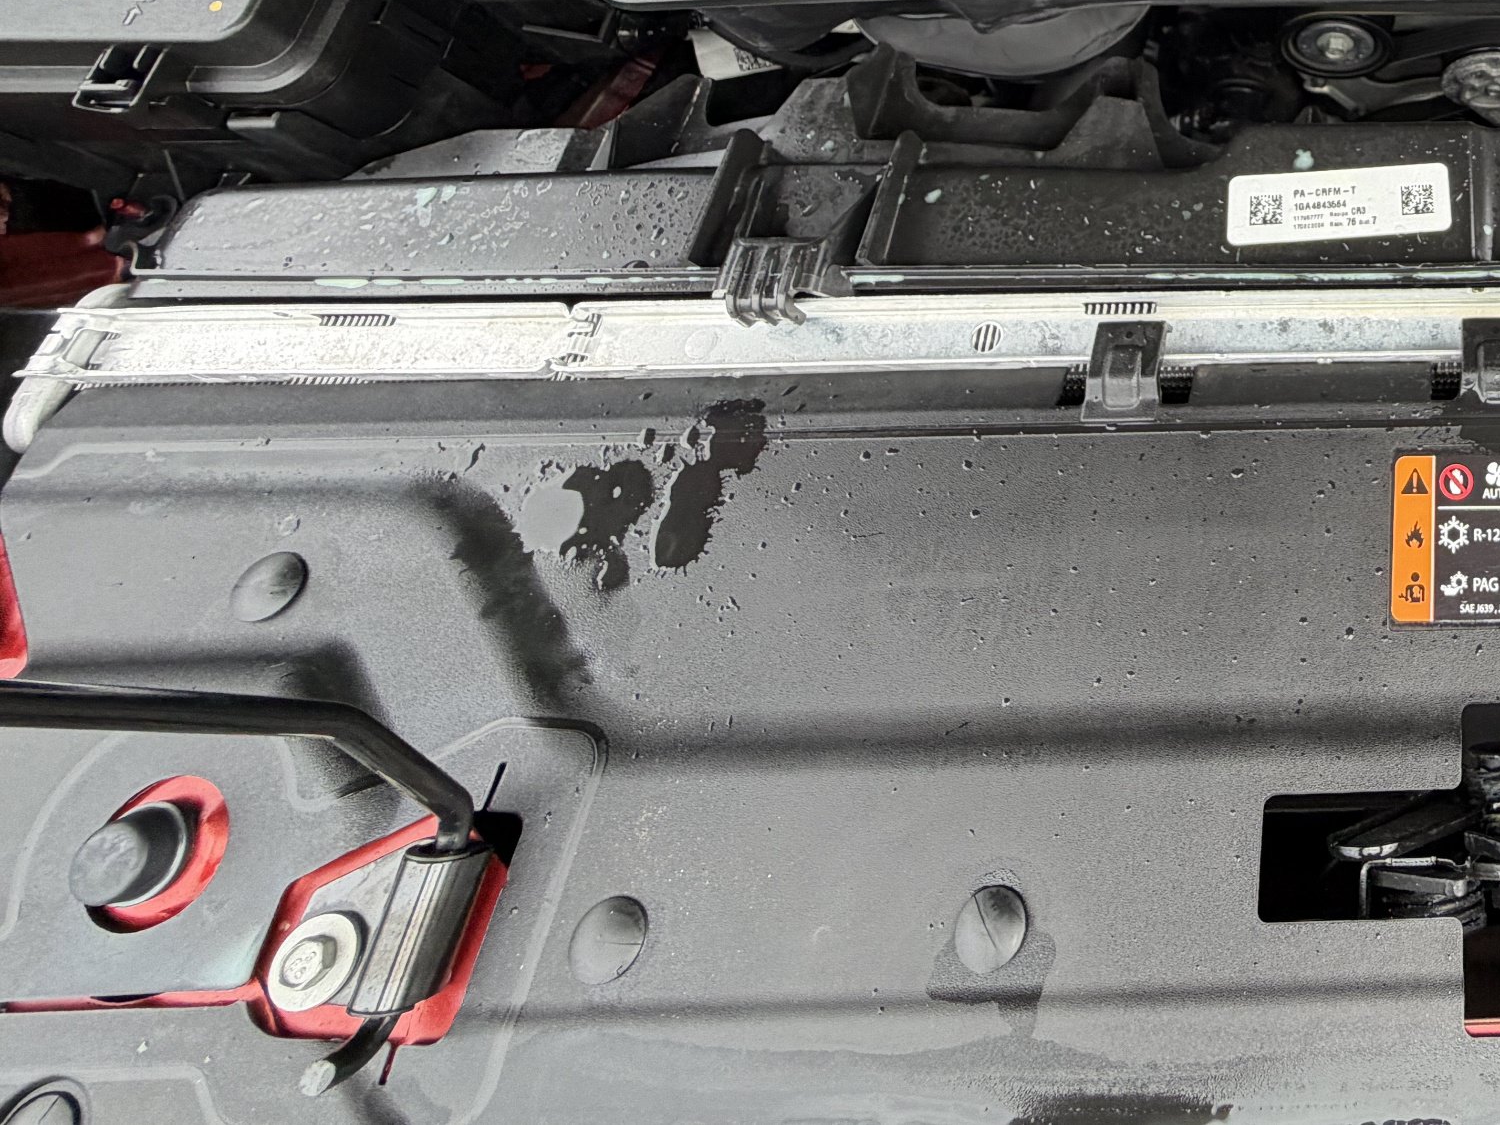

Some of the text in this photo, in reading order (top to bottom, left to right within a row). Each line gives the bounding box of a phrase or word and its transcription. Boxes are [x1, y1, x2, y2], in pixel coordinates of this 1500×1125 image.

[1371, 216, 1377, 225] 7
[1472, 577, 1499, 592] PAG
[1459, 604, 1475, 614] SAE
